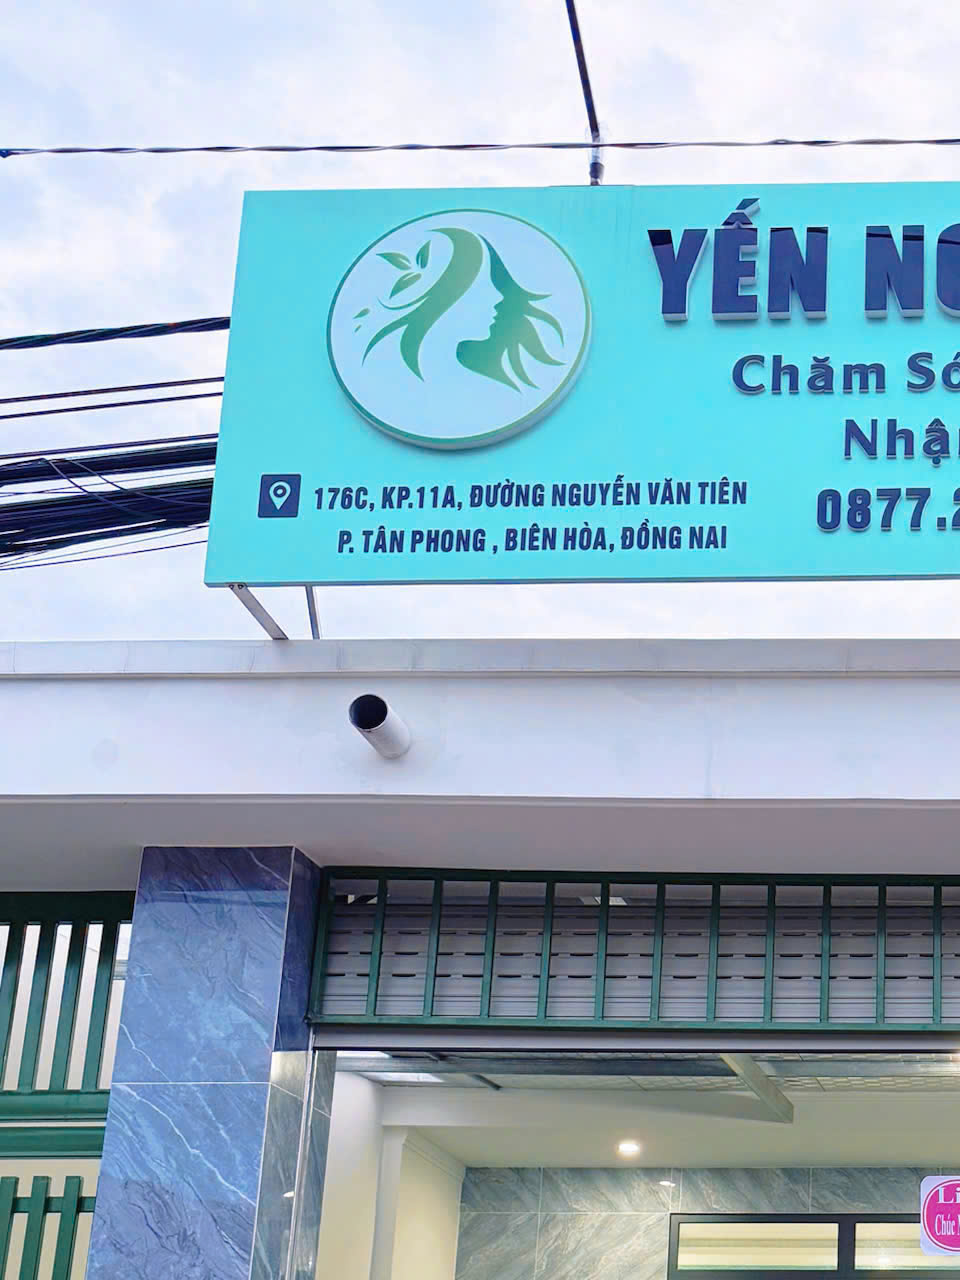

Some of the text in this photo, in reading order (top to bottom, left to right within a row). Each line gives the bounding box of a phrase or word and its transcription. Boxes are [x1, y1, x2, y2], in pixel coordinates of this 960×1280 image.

[648, 198, 828, 320] YẾN
[732, 354, 886, 394] Chăm
[315, 473, 747, 513] 176C, KP.11A, ĐƯỜNG NGUYỄN VĂN TIÊN
[337, 531, 353, 553] P.
[362, 527, 404, 553] TÂN
[505, 522, 556, 551] BIÊN
[564, 523, 614, 553] HÒA,
[620, 518, 682, 550] ĐỒNG
[689, 526, 727, 549] NAI
[935, 1213, 955, 1236] Chúc
